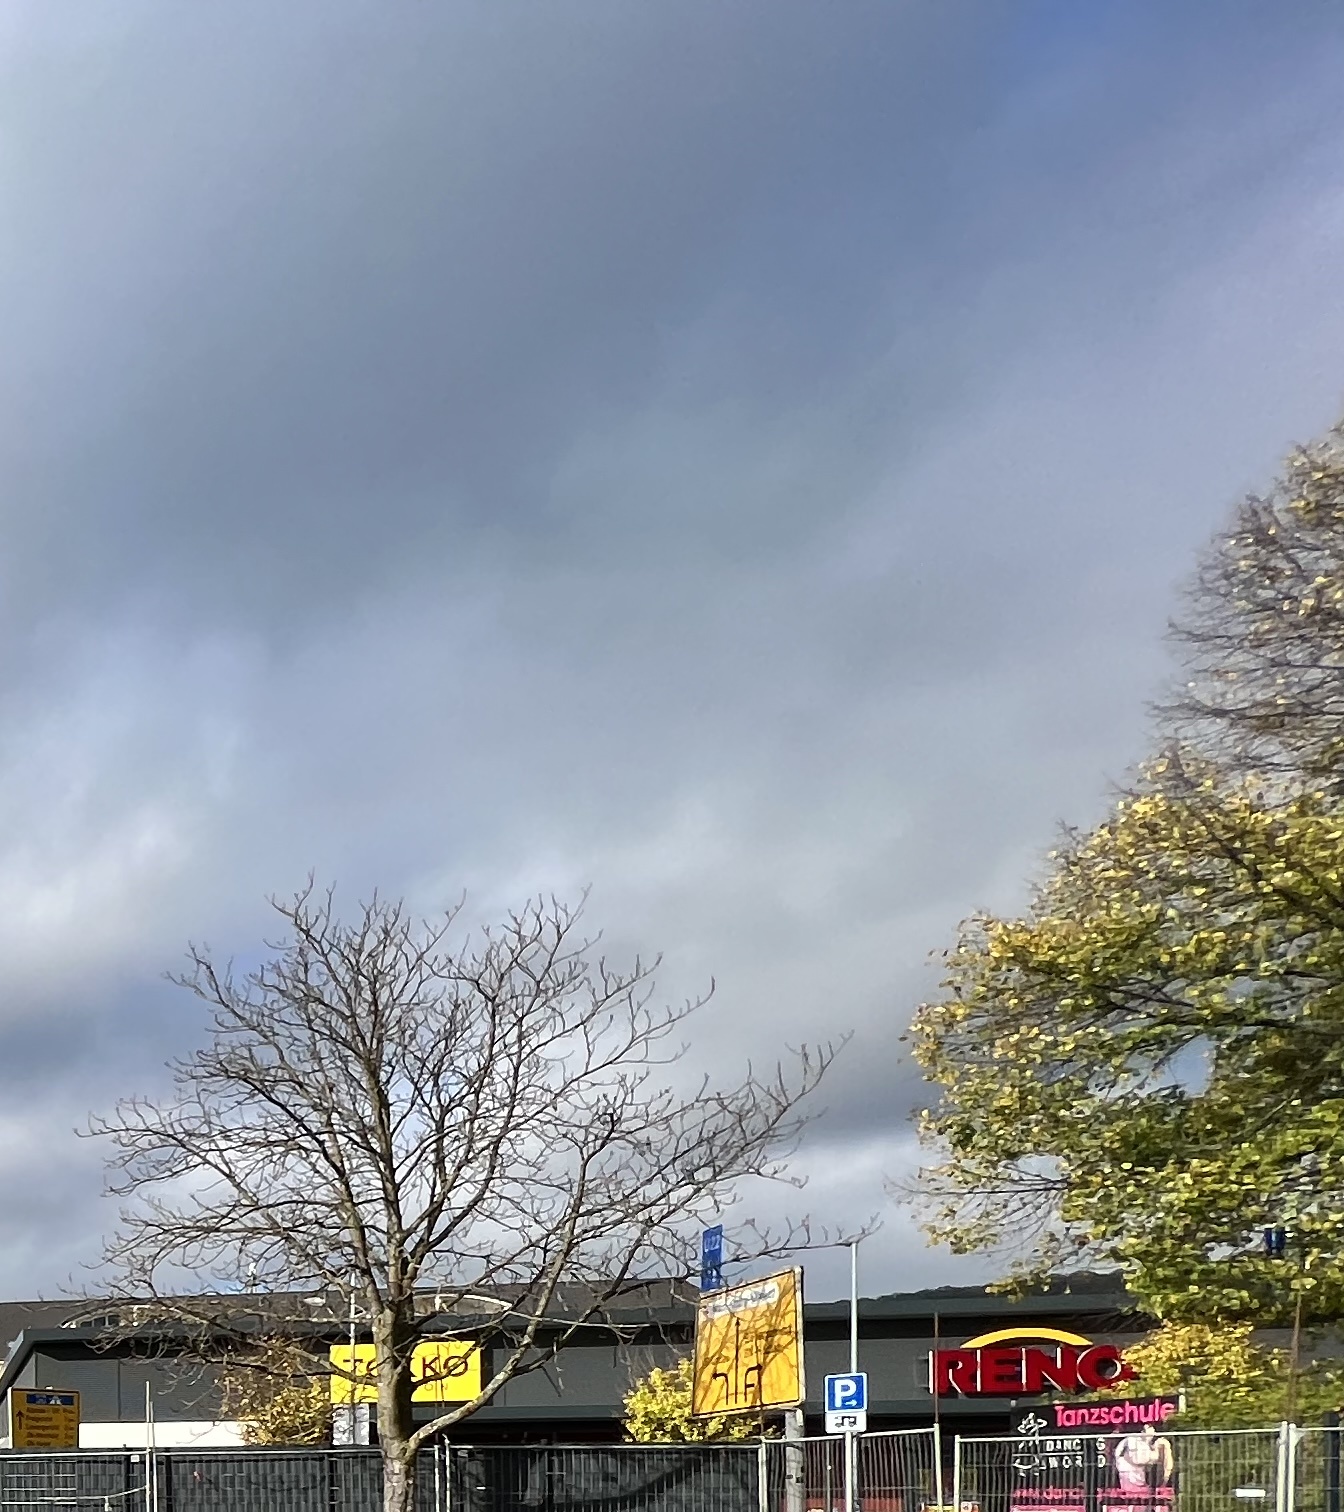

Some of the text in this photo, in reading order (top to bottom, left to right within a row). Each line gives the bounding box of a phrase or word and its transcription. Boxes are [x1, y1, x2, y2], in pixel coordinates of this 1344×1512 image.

[929, 1345, 1136, 1397] RENO
[834, 1379, 857, 1408] P
[1054, 1399, 1175, 1427] Tanzschule
[1046, 1437, 1106, 1452] DANCG
[1048, 1454, 1107, 1469] WORD
